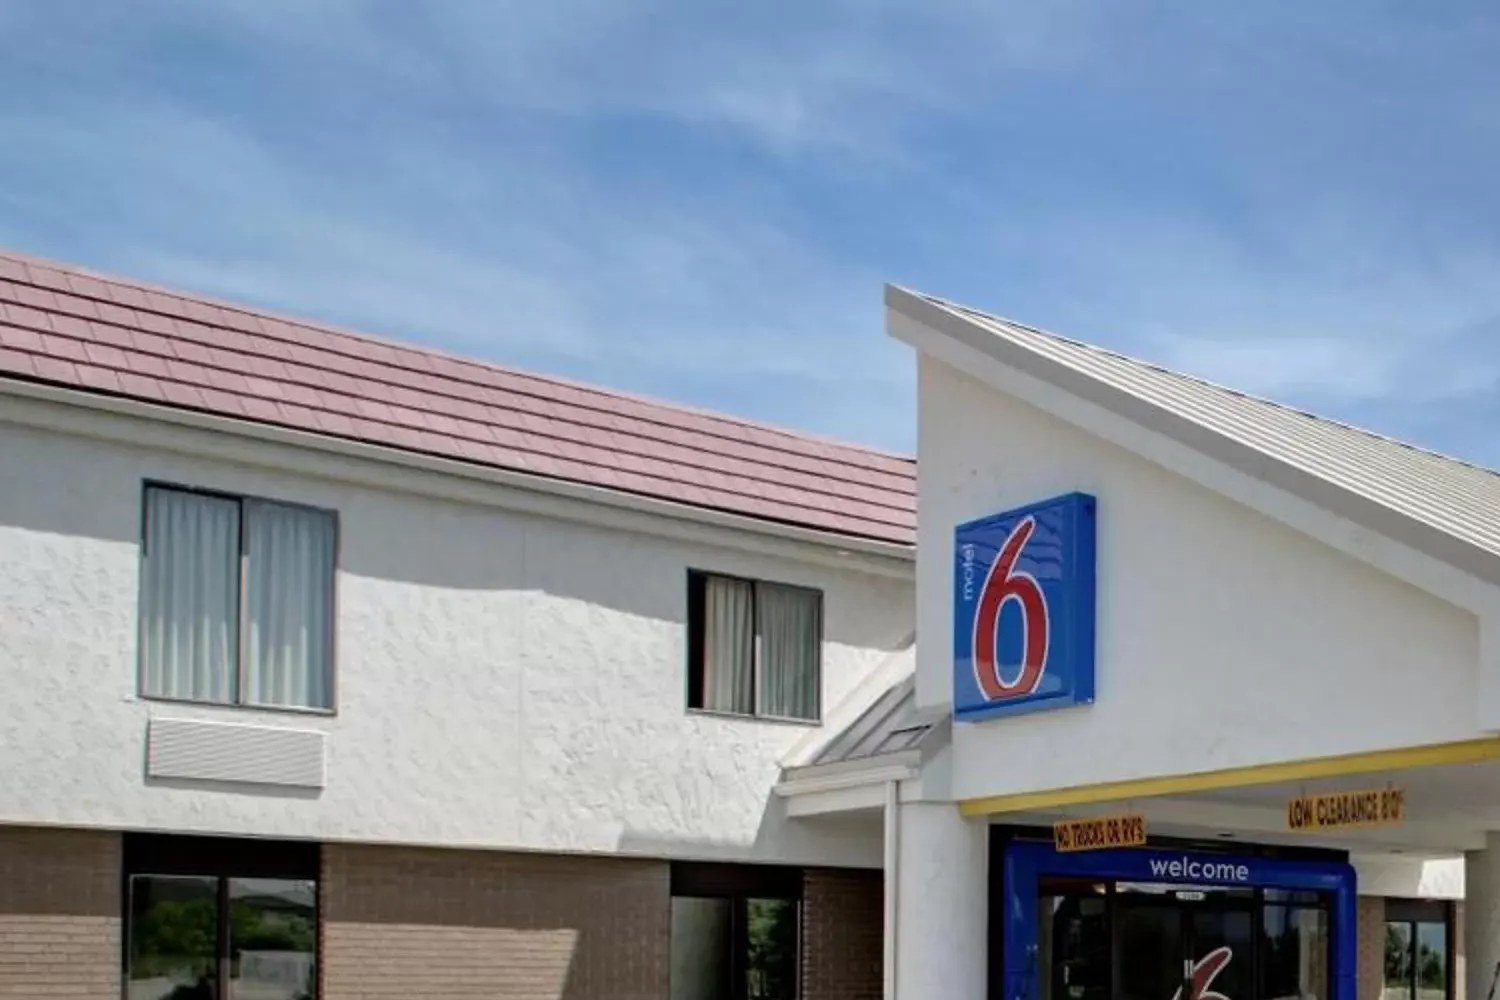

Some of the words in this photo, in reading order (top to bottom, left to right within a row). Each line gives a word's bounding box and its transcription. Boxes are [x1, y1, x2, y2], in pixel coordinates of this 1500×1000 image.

[962, 543, 974, 600] motel
[971, 515, 1050, 702] 6
[1288, 797, 1313, 829] LOW
[1317, 793, 1378, 826] CLEARANCE
[1056, 823, 1069, 848] NO
[1071, 820, 1105, 847] TRUCKS
[1107, 818, 1120, 844] OR
[1149, 855, 1249, 881] welcome
